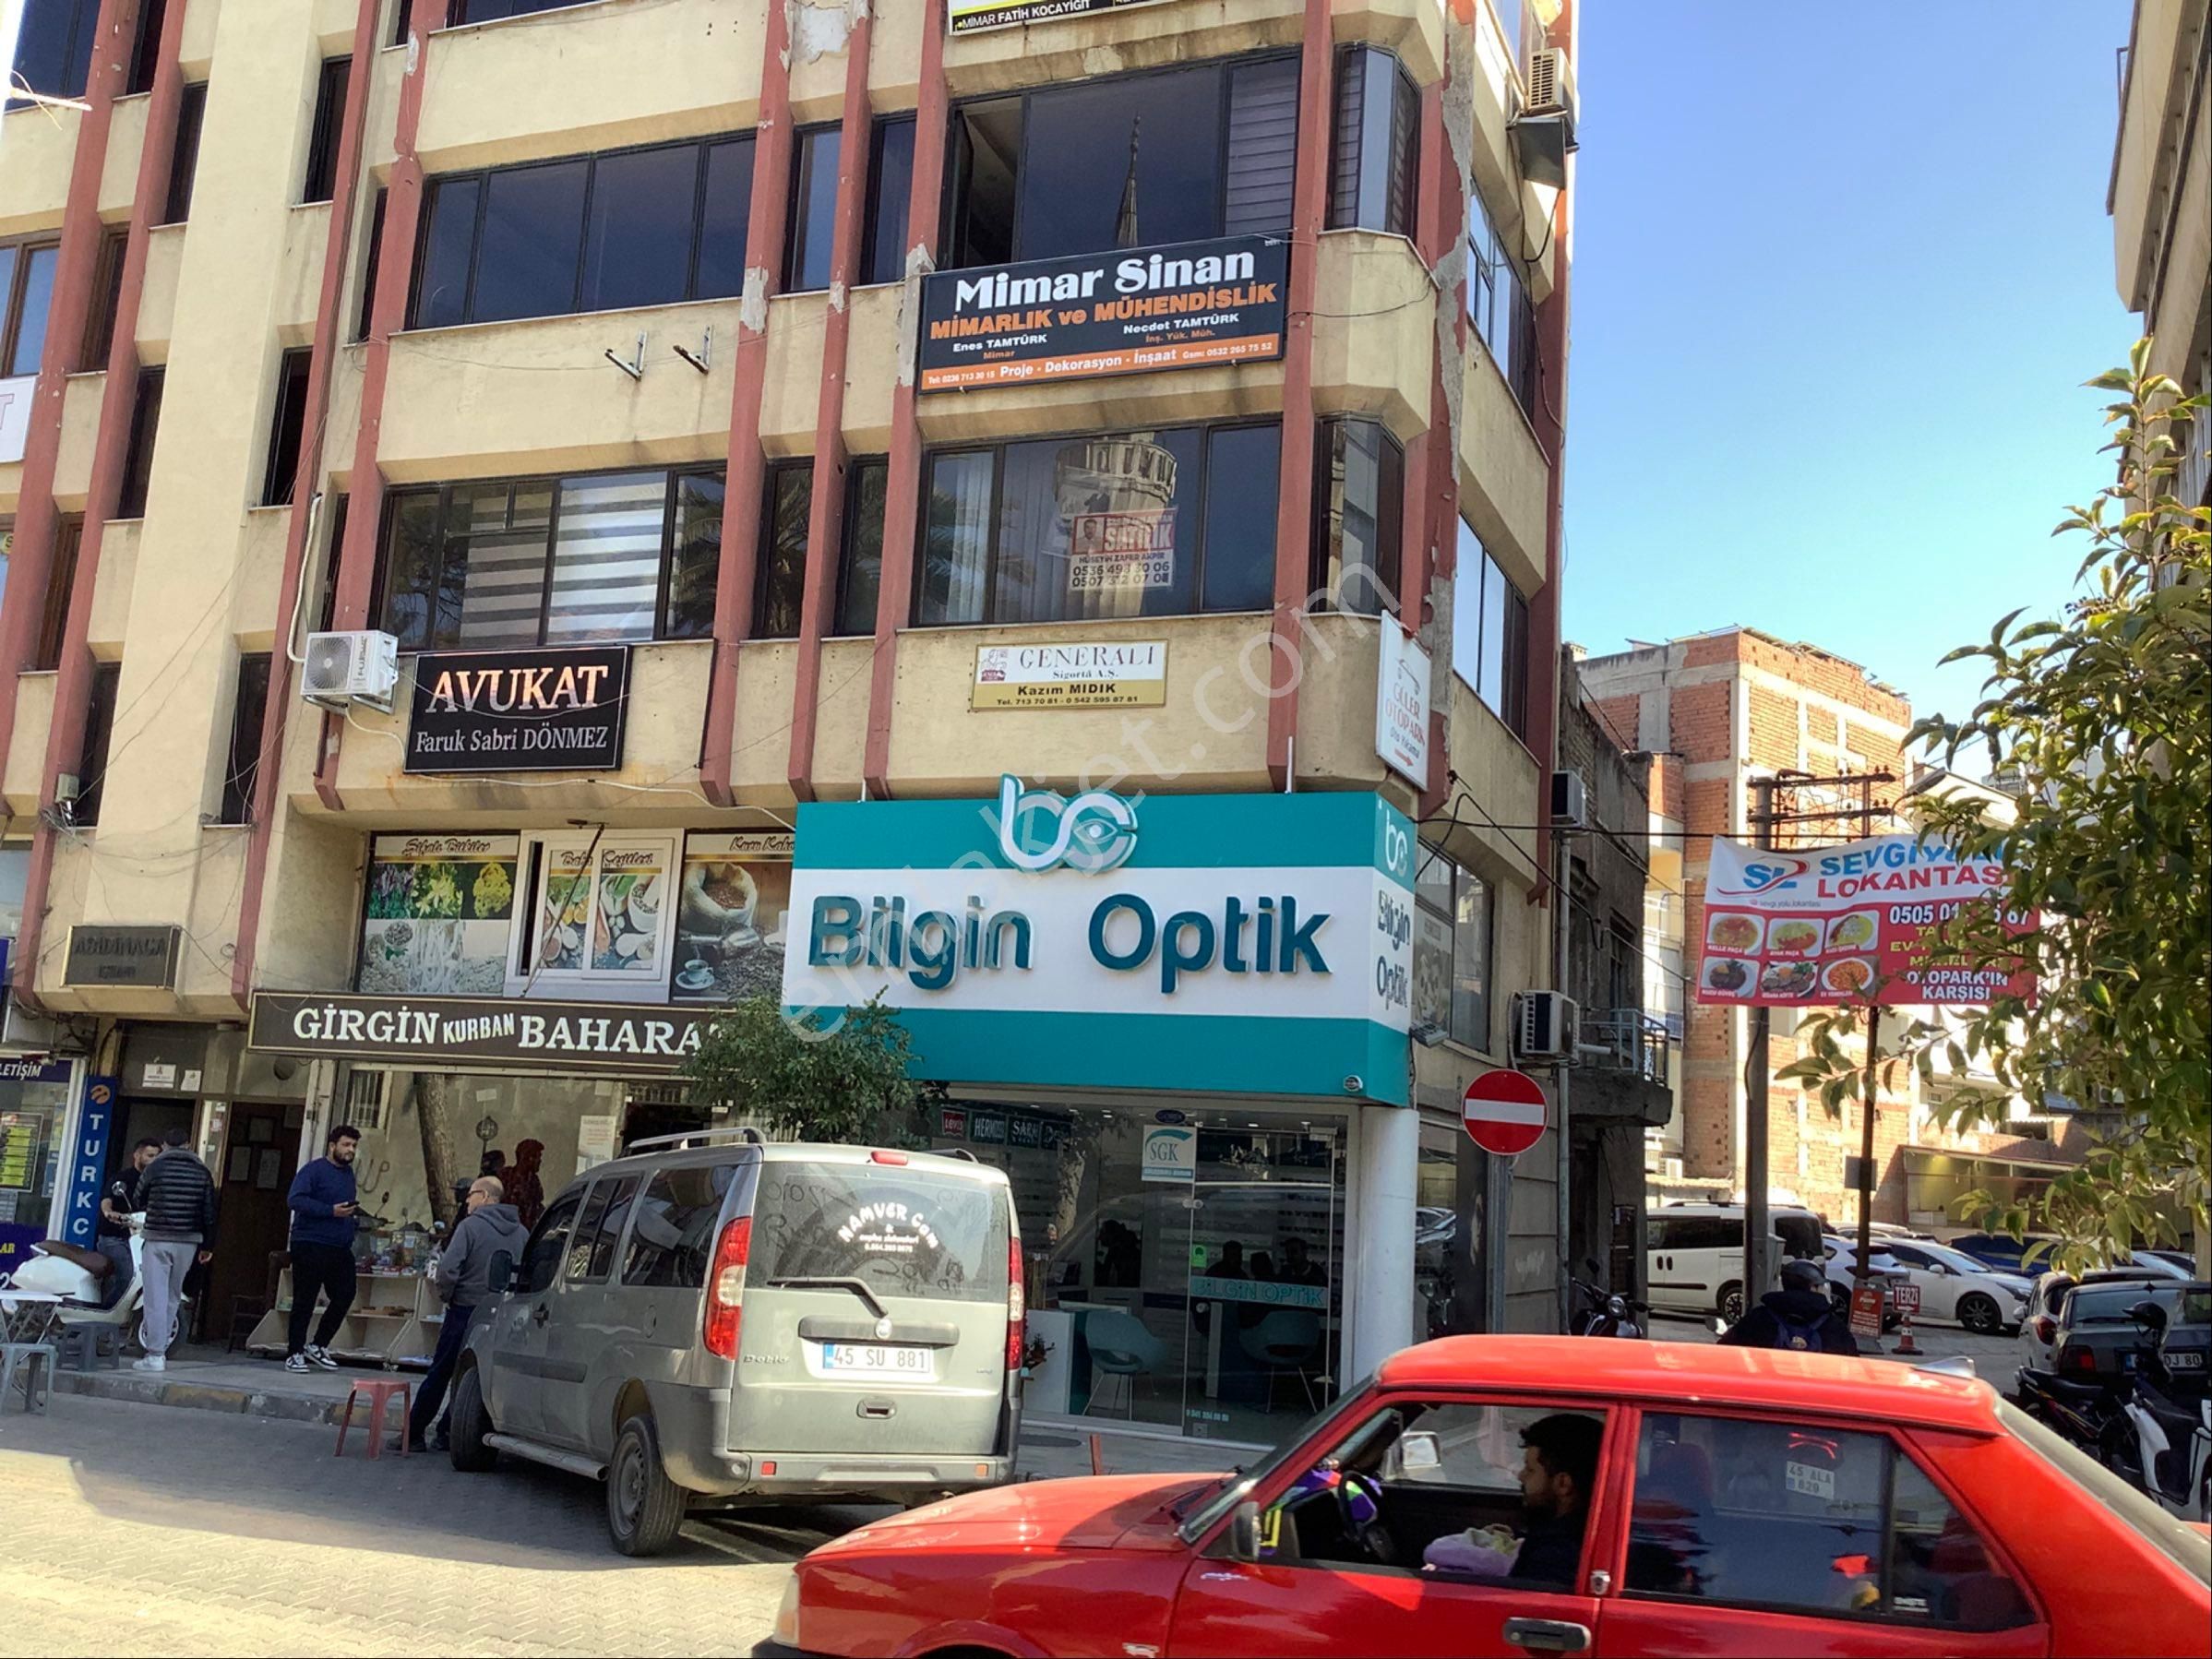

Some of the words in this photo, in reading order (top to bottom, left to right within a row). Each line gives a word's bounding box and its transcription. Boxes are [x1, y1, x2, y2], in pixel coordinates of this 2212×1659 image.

[998, 7, 1029, 23] FATİH
[954, 268, 1105, 312] Mimar
[1114, 251, 1255, 293] Sinan
[930, 309, 1053, 340] MİMARLIK
[1058, 310, 1087, 326] ve
[1094, 280, 1278, 322] MÜHENDİSLİK
[1123, 317, 1171, 334] Necdet
[1174, 312, 1240, 328] TAMTÜRK
[952, 341, 983, 352] Enes
[986, 333, 1047, 350] TAMTÜRK
[1000, 364, 1034, 379] Proje
[1046, 355, 1122, 373] Dekorasyon
[1134, 349, 1177, 365] İnşaat
[1020, 645, 1154, 670] GENERALI
[424, 664, 609, 714] AVUKAT
[1017, 685, 1063, 696] Kazım
[1069, 683, 1117, 695] MIDIK
[415, 730, 466, 753] Faruk
[470, 728, 518, 752] Sabri
[521, 722, 609, 751] DÖNMEZ
[1817, 865, 2005, 899] LOKANTAS
[1377, 889, 1411, 951] Bilgin
[1889, 904, 1934, 925] 0505
[808, 893, 1034, 991] Bilgin
[1087, 892, 1333, 995] Optik
[1376, 955, 1408, 1010] Optik
[1922, 986, 1991, 1003] KARŞISI
[293, 1003, 441, 1044] GİRGİN
[442, 1013, 515, 1044] KURBAN
[518, 1016, 722, 1057] BAHARA
[1150, 1141, 1178, 1162] SGK
[837, 1201, 908, 1243] NAMVER
[1895, 1286, 1919, 1305] TERZİ
[833, 1347, 855, 1366] 45
[866, 1349, 886, 1367] SU
[896, 1351, 926, 1368] 881
[1788, 1464, 1804, 1477] 45
[1810, 1469, 1832, 1485] ALA
